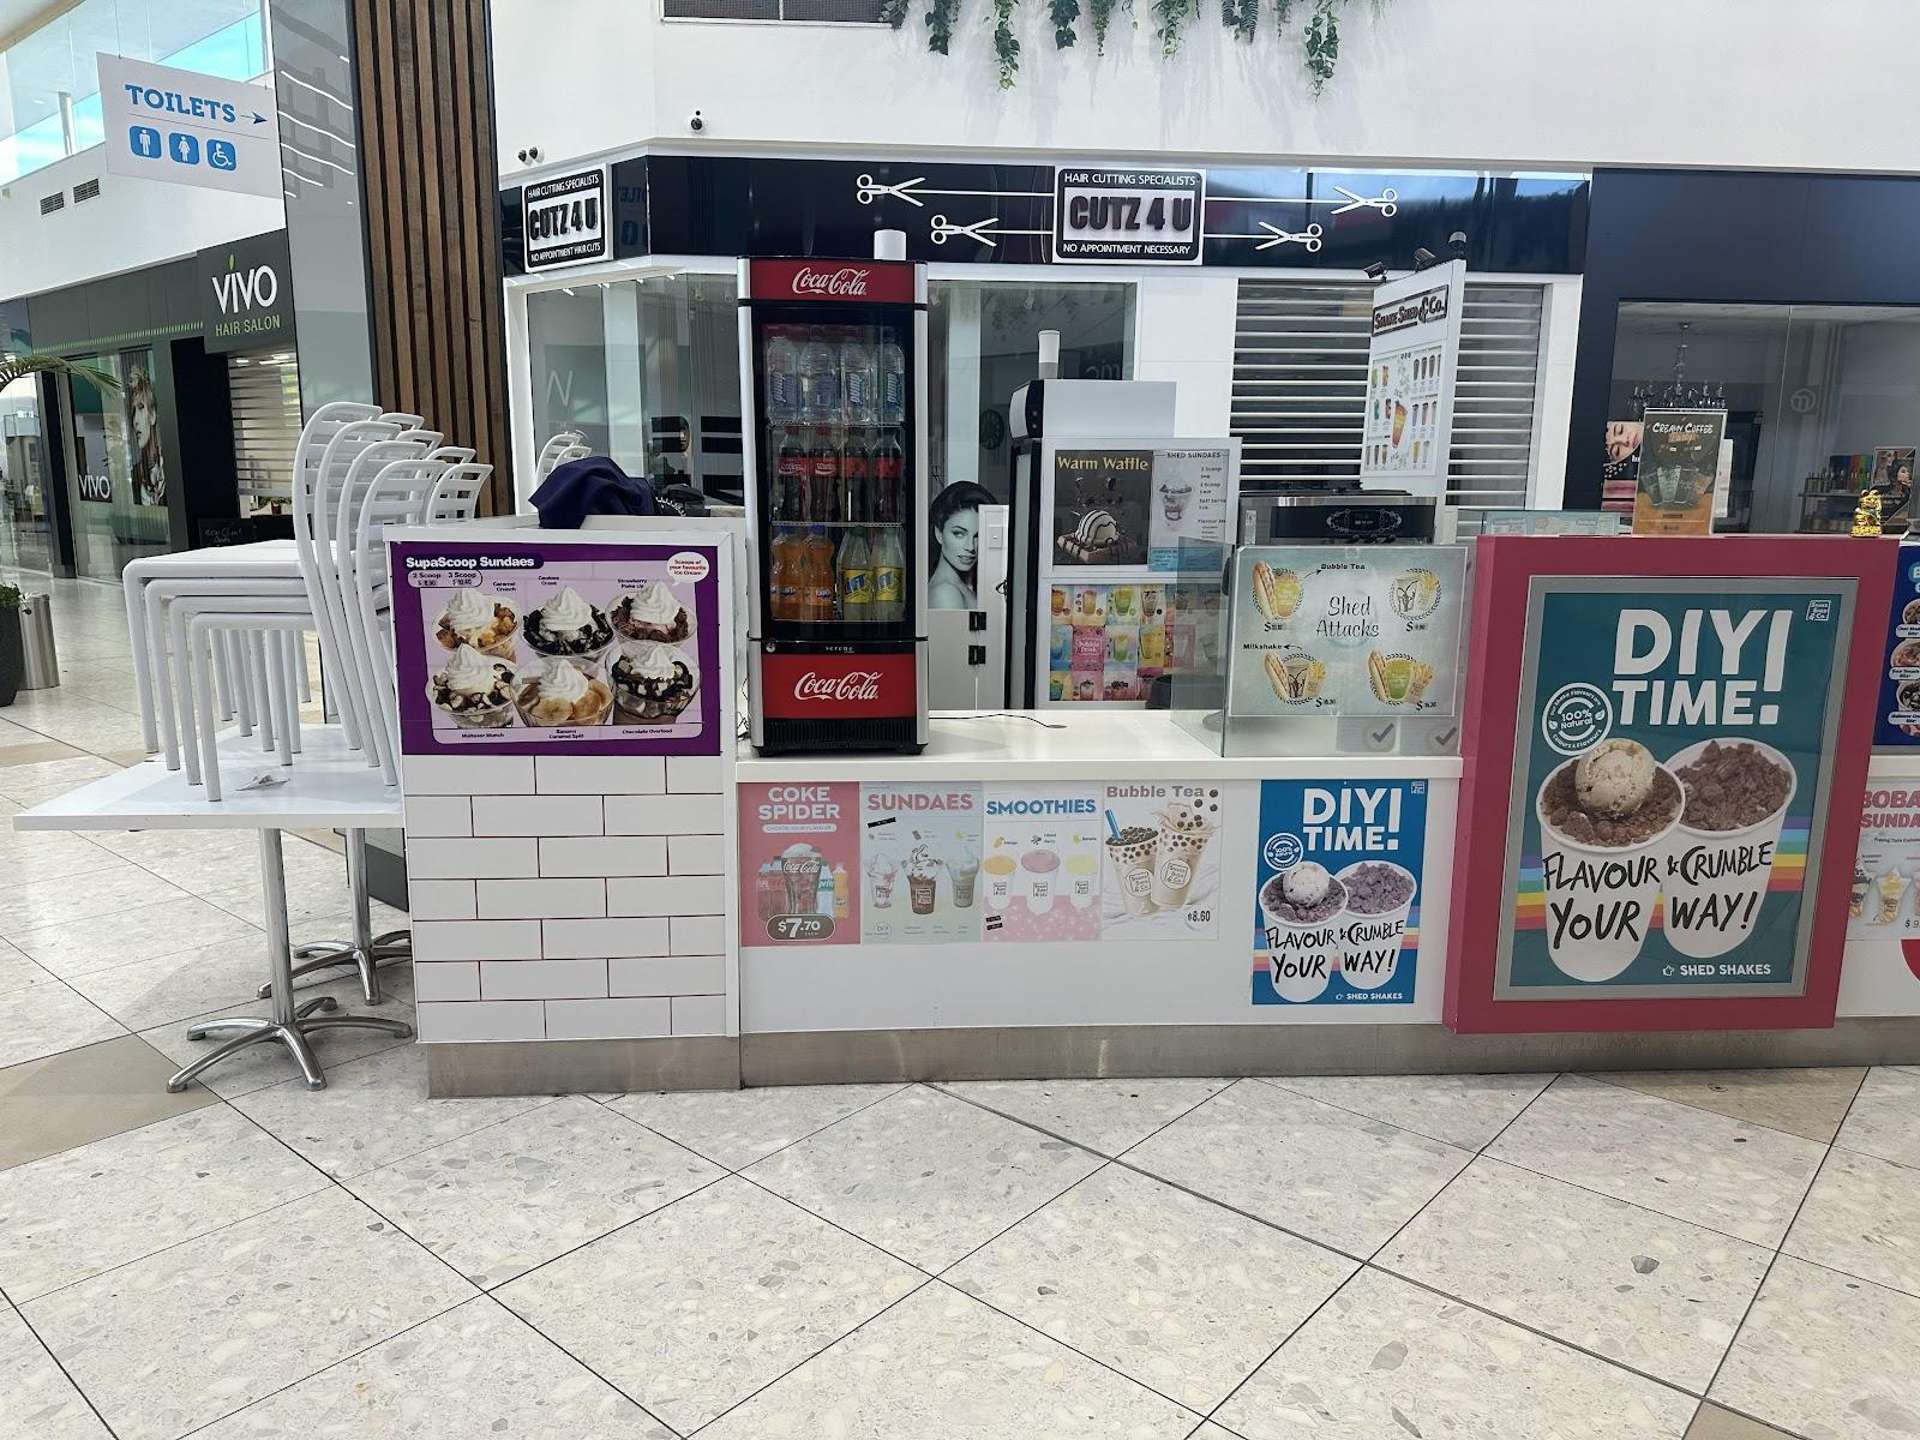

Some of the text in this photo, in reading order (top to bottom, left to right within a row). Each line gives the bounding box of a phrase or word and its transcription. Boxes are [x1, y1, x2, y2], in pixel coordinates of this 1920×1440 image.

[125, 84, 236, 123] TOILETS
[528, 173, 600, 197] HAIR CUTTING SPECIALISTS
[1064, 173, 1196, 186] HAIR CUTTING SPECIALISTS
[529, 197, 598, 241] CUTZ 4 U
[1069, 195, 1192, 232] CUTZ 4 U
[531, 253, 539, 262] NO
[587, 242, 601, 253] CUTS
[1063, 243, 1191, 255] NO APPOINTMENT NECESSARY
[212, 264, 278, 314] VIVO
[792, 267, 872, 295] Coca-Cola
[215, 315, 281, 337] HAIR SALON
[1057, 456, 1149, 471] Warm Waffle
[79, 475, 110, 499] VIVO
[406, 556, 534, 569] SupaScoop Sundaes
[1328, 596, 1370, 616] Shed
[1316, 619, 1380, 637] Attacks
[794, 671, 884, 700] Coca-Cola
[1561, 717, 1593, 729] Natural
[1562, 708, 1592, 722] 100%
[768, 786, 830, 802] COKE
[1106, 785, 1205, 798] Bubble Tea
[758, 804, 840, 820] SPIDER
[867, 793, 973, 811] SUNDAES
[986, 799, 1097, 816] SMOOTHIES
[1542, 841, 1773, 892] FLAVOUR & CRUMBLE
[1551, 891, 1758, 949] YOUR WAY!
[1266, 920, 1404, 950] FLAVOUR & CRUMBLE
[1272, 949, 1396, 984] YOUR WAY!
[1680, 964, 1771, 976] SHED SHAKES
[1370, 992, 1403, 1000] SHAKES
